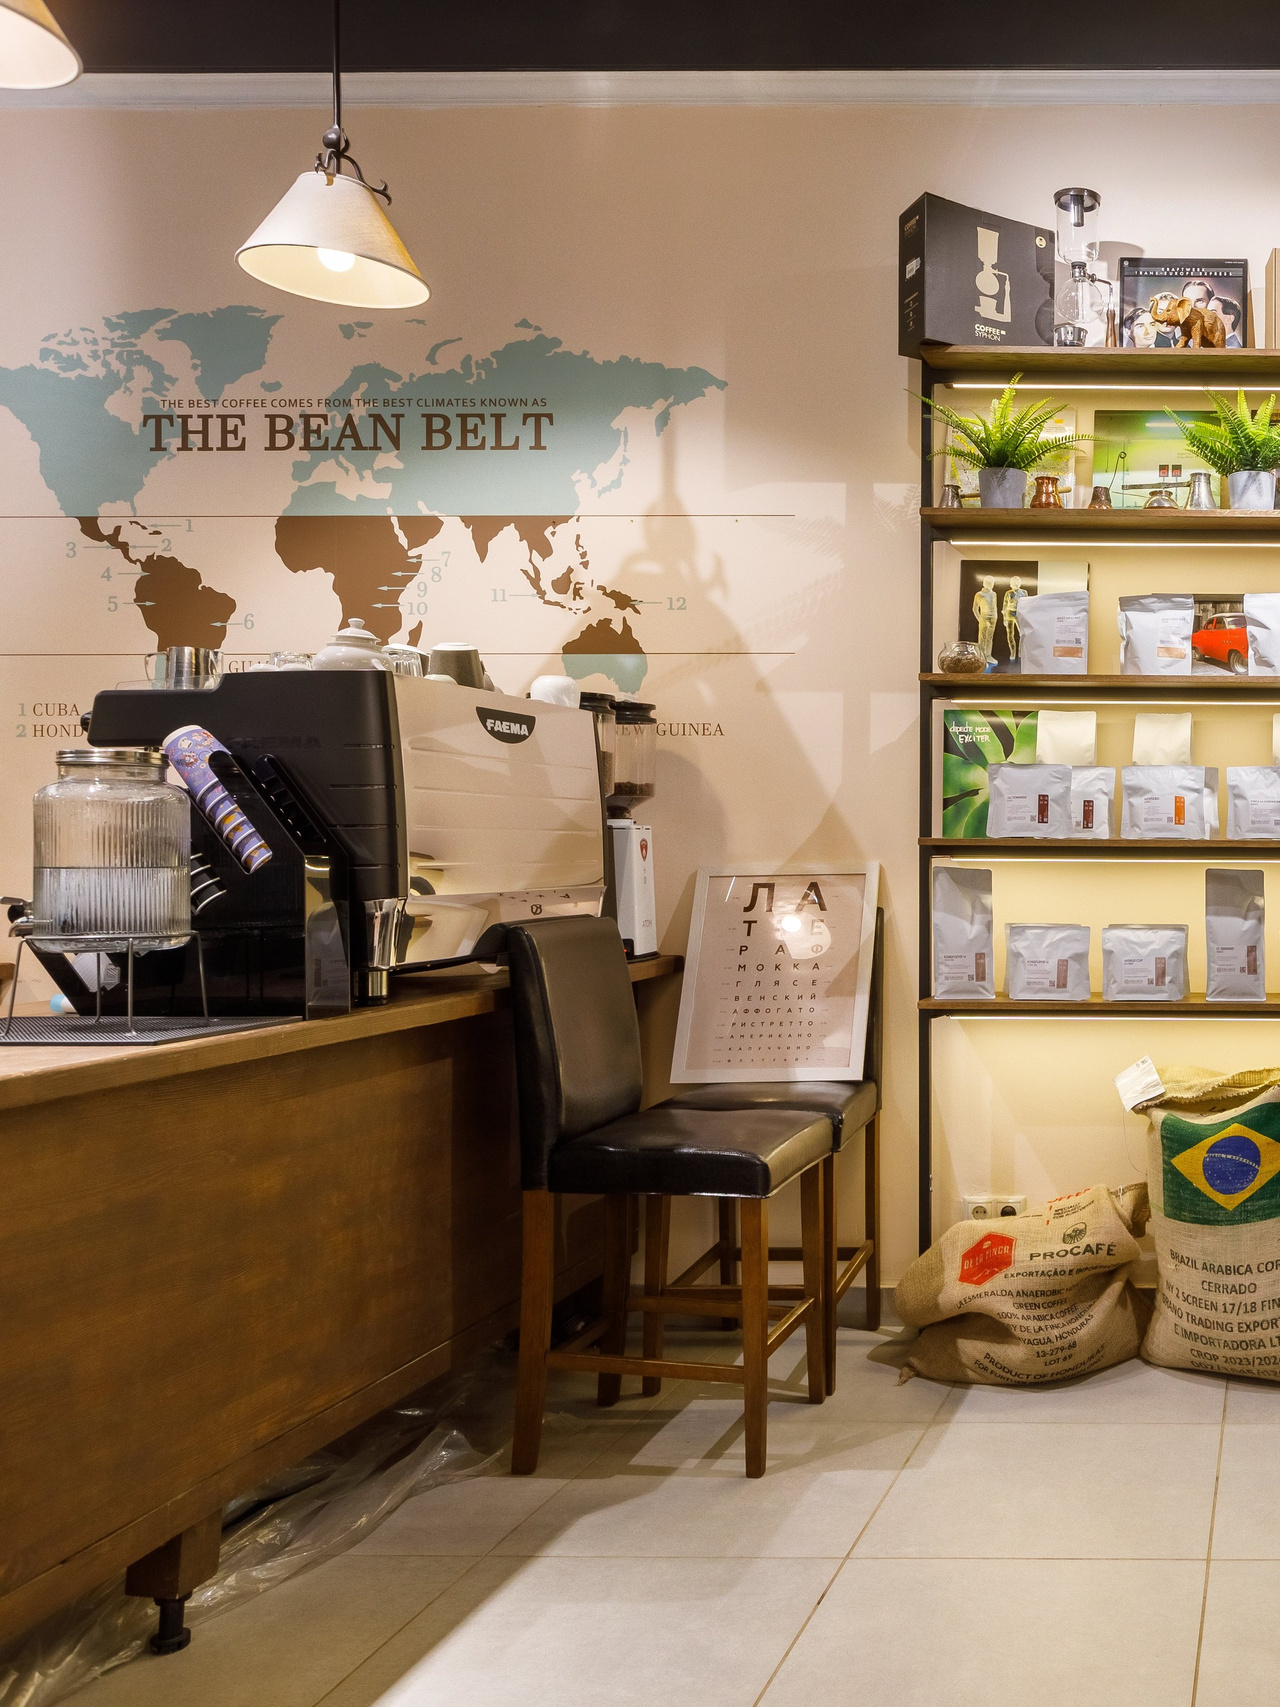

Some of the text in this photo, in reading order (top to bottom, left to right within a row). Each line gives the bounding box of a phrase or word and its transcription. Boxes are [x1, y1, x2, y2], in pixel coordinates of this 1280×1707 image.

[974, 323, 1001, 335] COFFEE
[974, 330, 1001, 342] SYPHON
[160, 398, 547, 408] THE BEST COFFEE COMES FROM THE BEST CLIMATES KNOWN AS
[142, 412, 554, 451] THE BEAN BELT
[185, 519, 194, 532] 1
[65, 541, 77, 558] 3
[161, 538, 172, 552] 2
[441, 551, 451, 567] 7
[101, 566, 112, 581] 4
[430, 566, 443, 583] 8
[416, 581, 428, 598] 9
[490, 588, 508, 602] 11
[107, 596, 118, 612] 5
[407, 601, 428, 615] 10
[666, 597, 687, 611] 12
[243, 613, 255, 629] 6
[18, 703, 81, 717] 1 CUBA
[15, 724, 27, 737] 2
[486, 718, 529, 736] FAEMA
[656, 722, 725, 736] GUINEA
[985, 1245, 1010, 1261] FINCA
[1029, 1241, 1117, 1261] PROCAFÉ
[1169, 1249, 1198, 1270] BRAZIL
[1201, 1262, 1253, 1275] ARABICA
[1004, 1265, 1075, 1279] EXPORTAÇÃO E
[1201, 1280, 1257, 1295] CERRADO
[963, 1289, 1015, 1306] ESMERALDA
[1015, 1288, 1065, 1298] ANAEROBIC
[1013, 1297, 1068, 1310] GREEN COFFEE
[1165, 1280, 1175, 1294] NY
[1175, 1287, 1180, 1298] 2
[1181, 1291, 1218, 1312] SCREEN
[1222, 1301, 1257, 1316] 17/18
[997, 1303, 1079, 1322] 100% ARABICA COFFEE
[1020, 1326, 1031, 1334] DE
[1033, 1325, 1044, 1334] LA
[1045, 1321, 1066, 1332] FINCA
[1055, 1313, 1094, 1343] HONDURAS
[1185, 1312, 1234, 1333] TRADING
[1173, 1322, 1180, 1335] E
[1181, 1327, 1266, 1351] IMPORTADORA
[1035, 1341, 1077, 1358] 13-279-68
[1190, 1349, 1219, 1362] CROP
[974, 1359, 989, 1372] FOR
[983, 1343, 1105, 1380] PRODUCT OF HONDURAS
[1044, 1353, 1073, 1367] LOT 69
